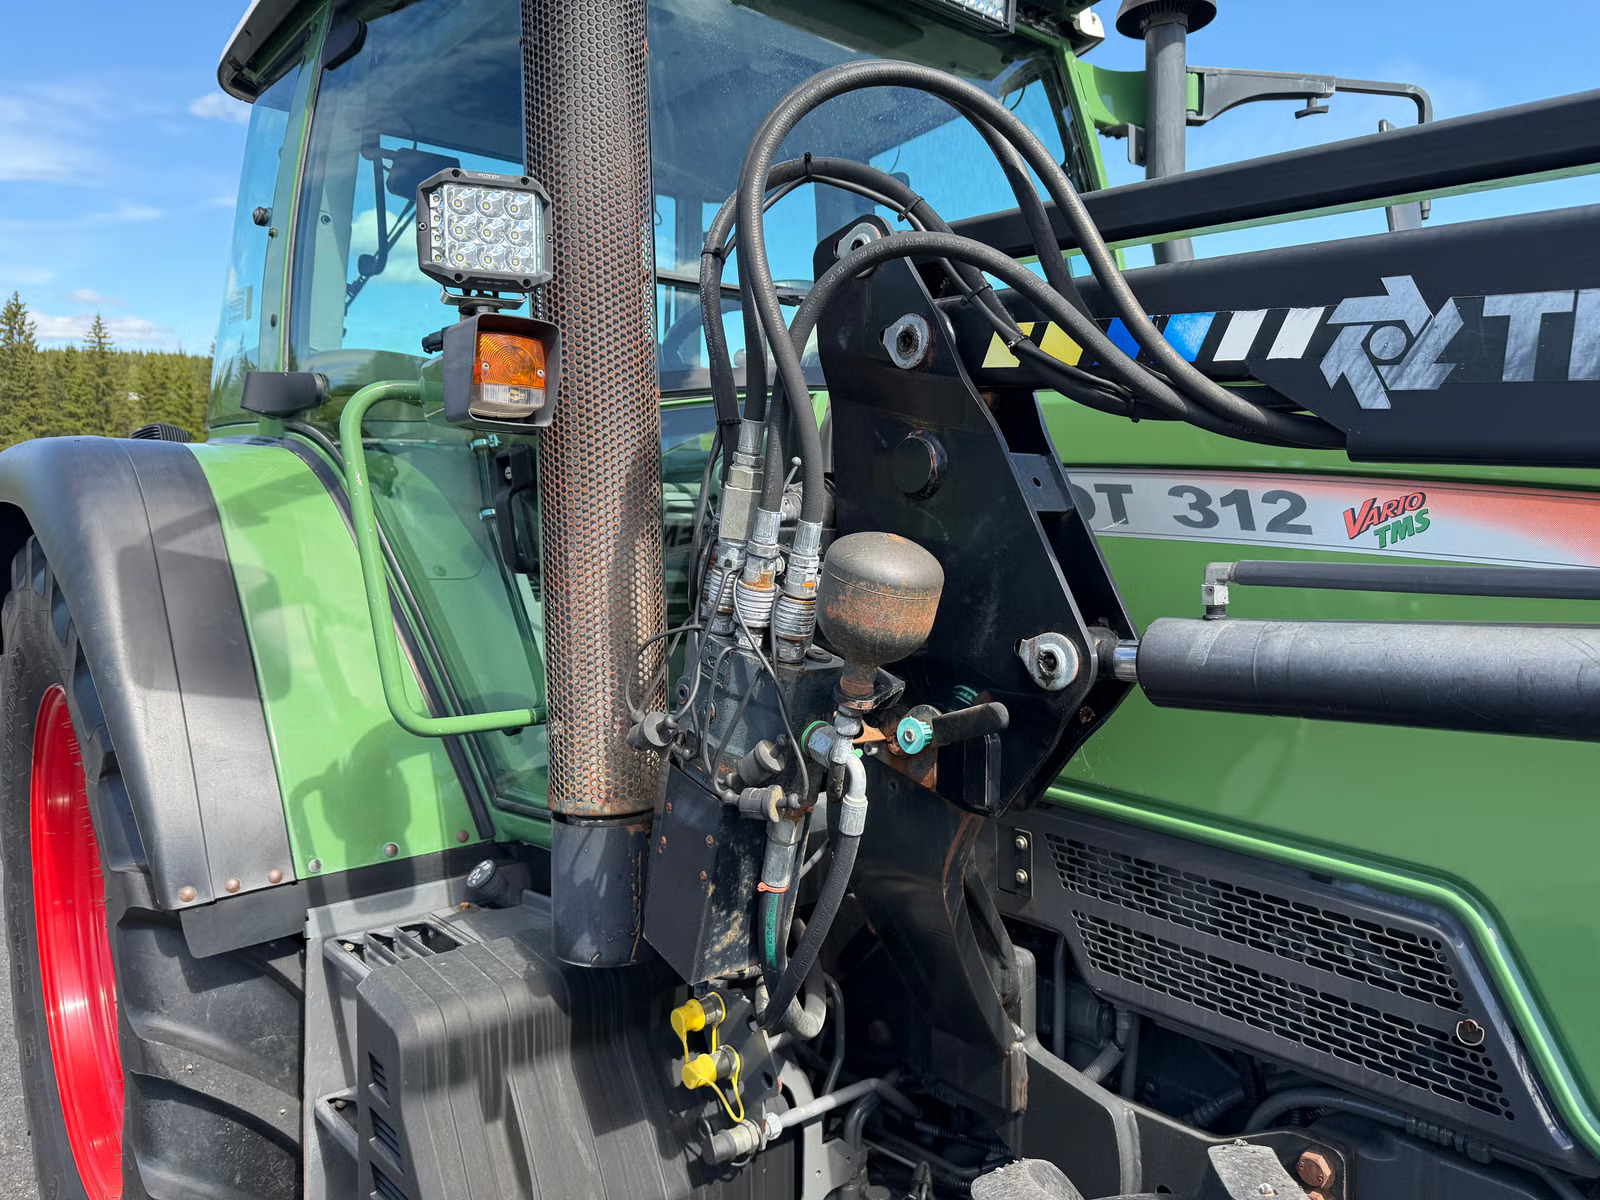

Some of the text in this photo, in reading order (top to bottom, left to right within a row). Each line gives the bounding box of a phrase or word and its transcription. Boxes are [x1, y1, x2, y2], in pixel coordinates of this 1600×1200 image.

[1168, 485, 1313, 535] 312
[1343, 491, 1427, 540] VARIO
[1374, 508, 1431, 549] TMS
